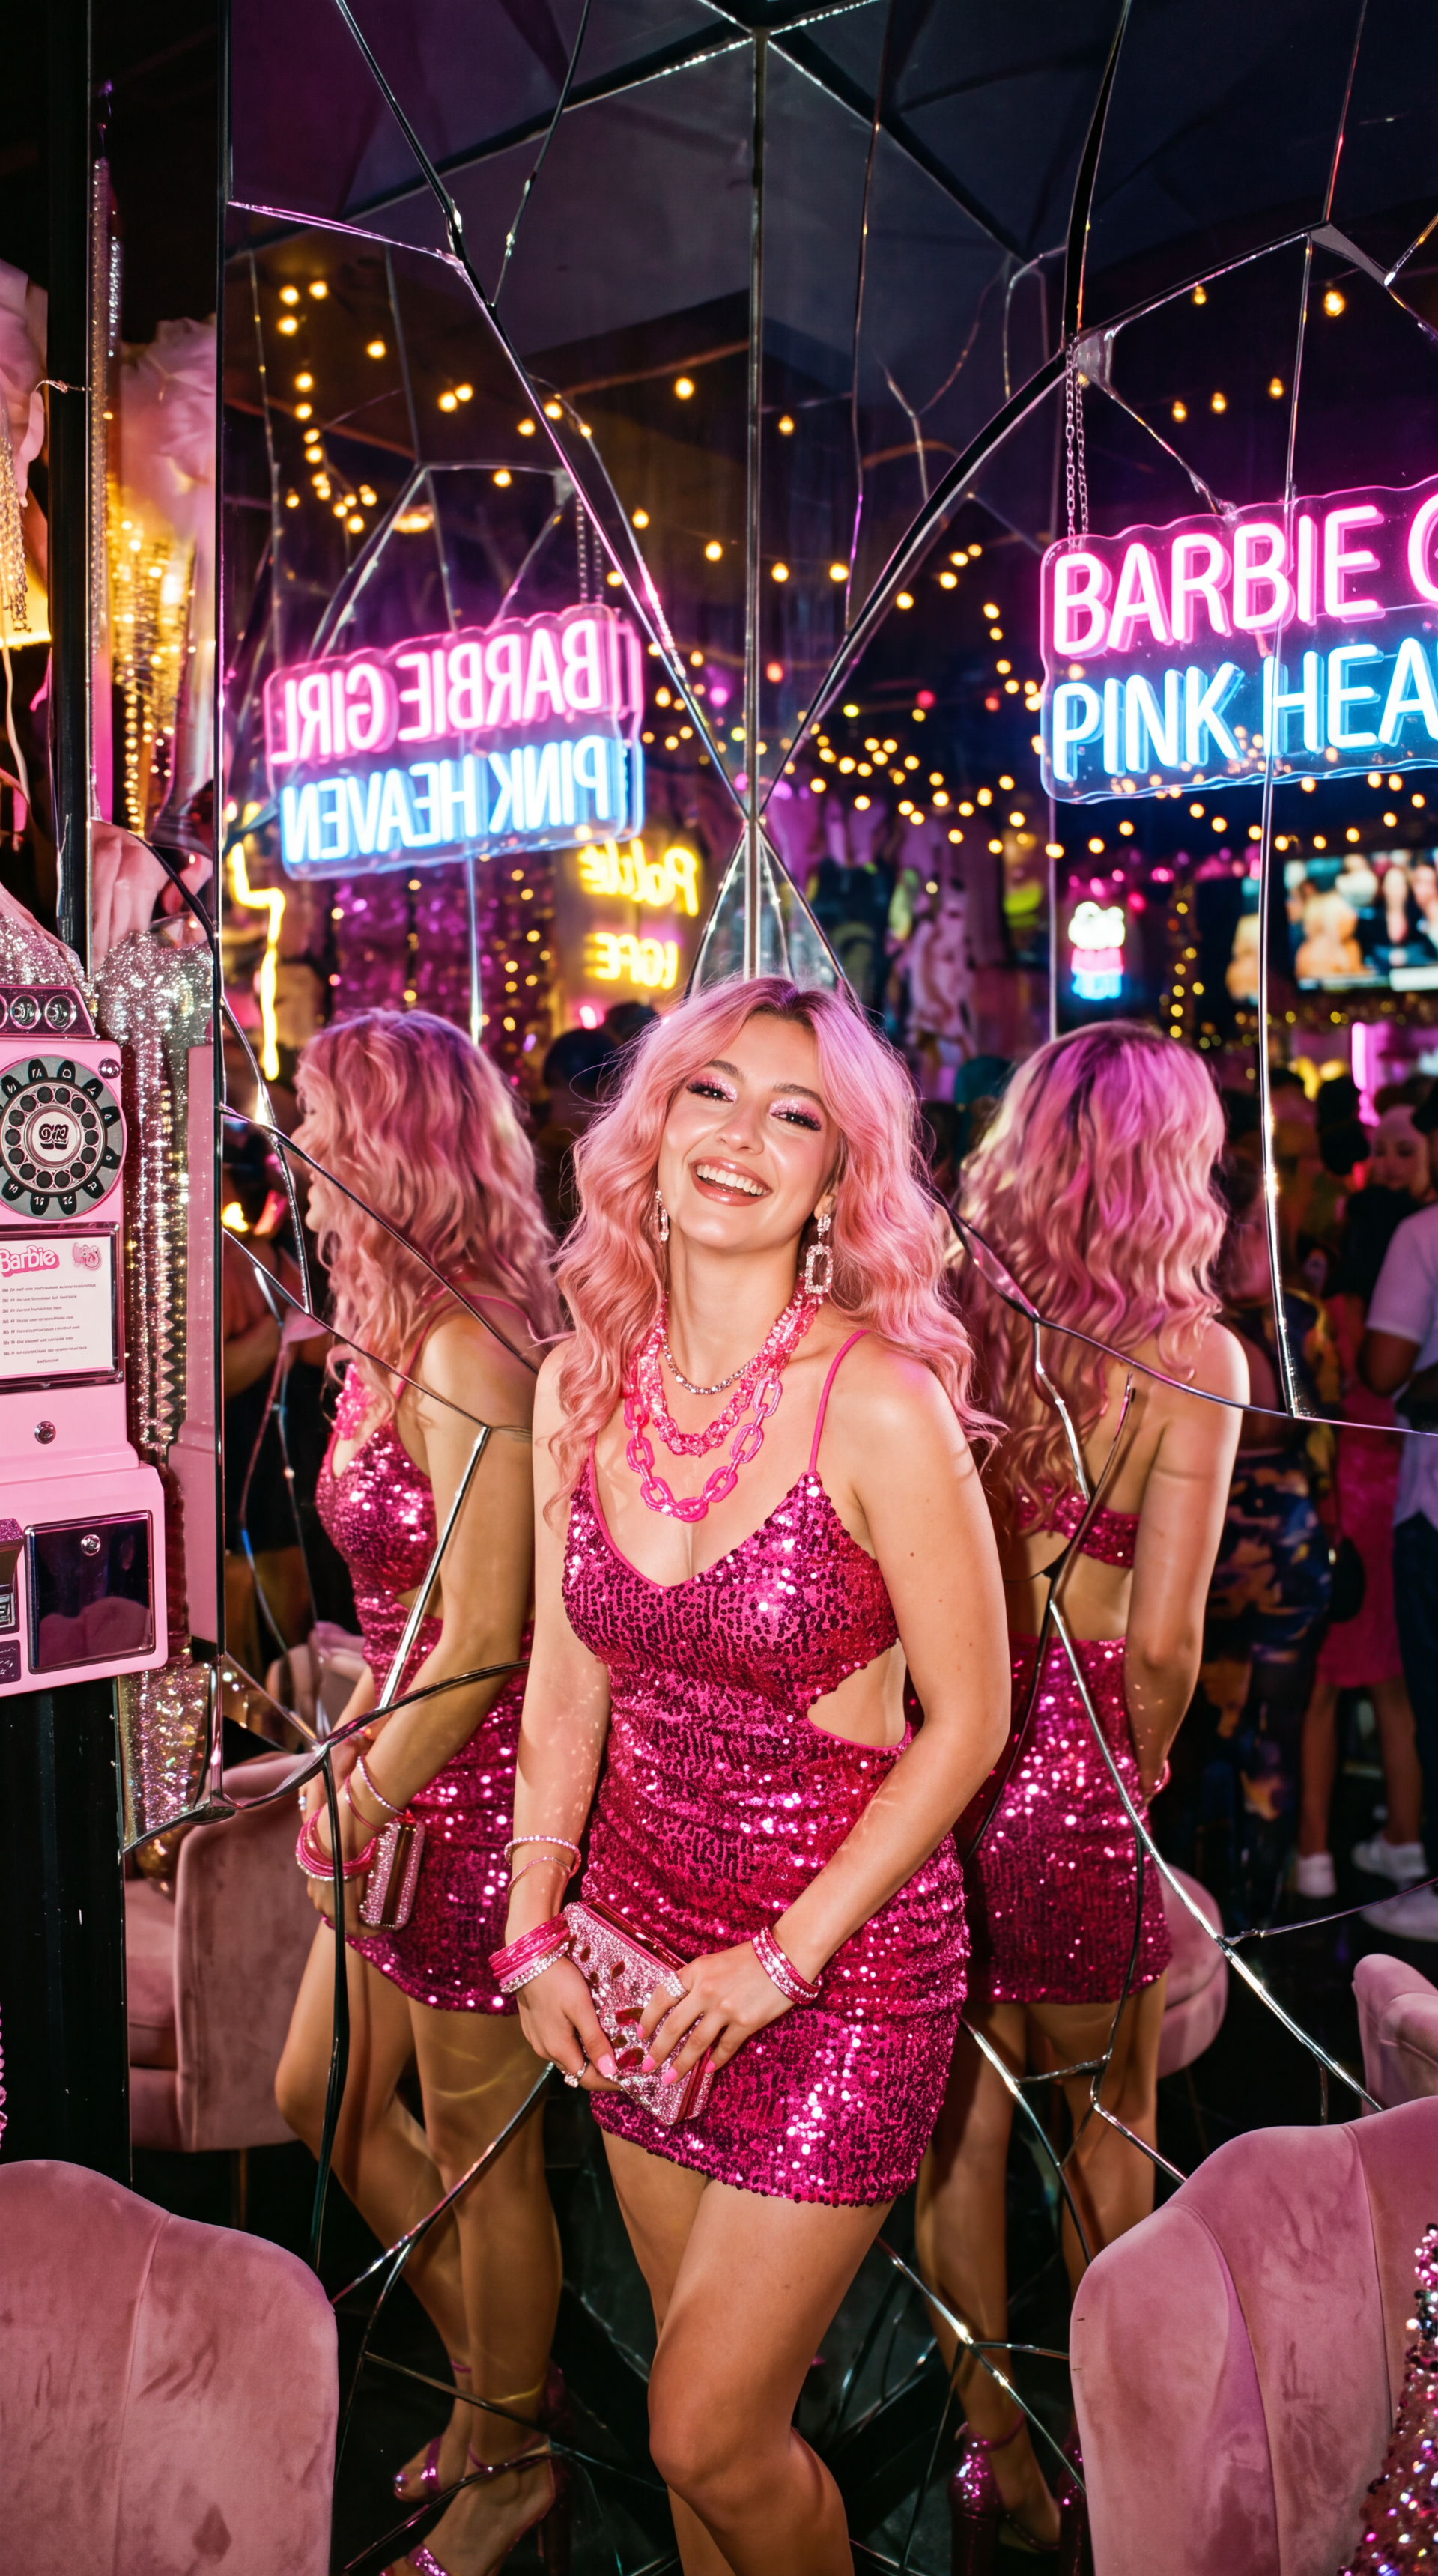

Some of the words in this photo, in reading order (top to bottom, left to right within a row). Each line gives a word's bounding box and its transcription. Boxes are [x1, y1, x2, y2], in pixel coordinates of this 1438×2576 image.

[1052, 504, 1384, 657] BARBIE
[1052, 661, 1243, 782] PINK
[1263, 637, 1438, 756] HEA
[0, 1245, 60, 1278] Barbie
